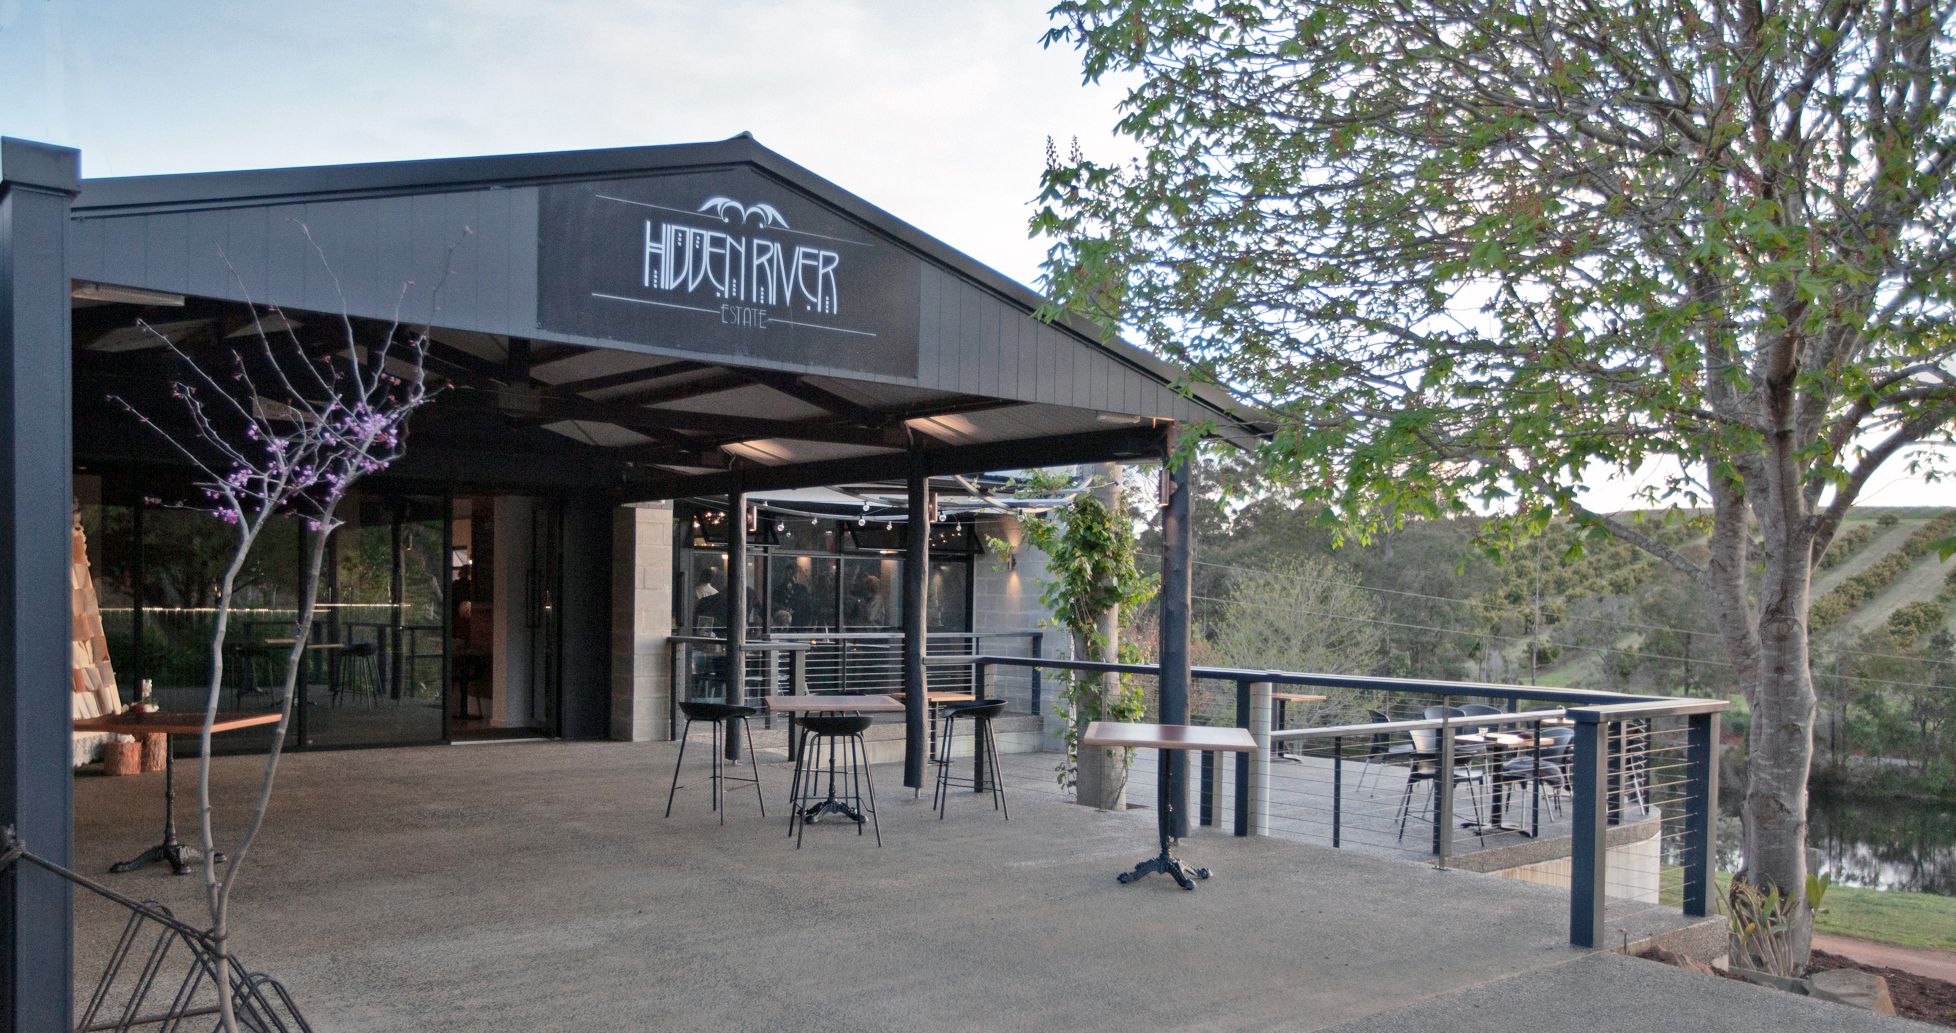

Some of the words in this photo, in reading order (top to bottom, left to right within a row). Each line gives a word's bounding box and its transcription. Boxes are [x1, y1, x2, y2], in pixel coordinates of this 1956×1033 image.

[644, 220, 745, 300] HIDDEN
[753, 239, 839, 314] RIVER
[721, 304, 767, 328] ESTATE
